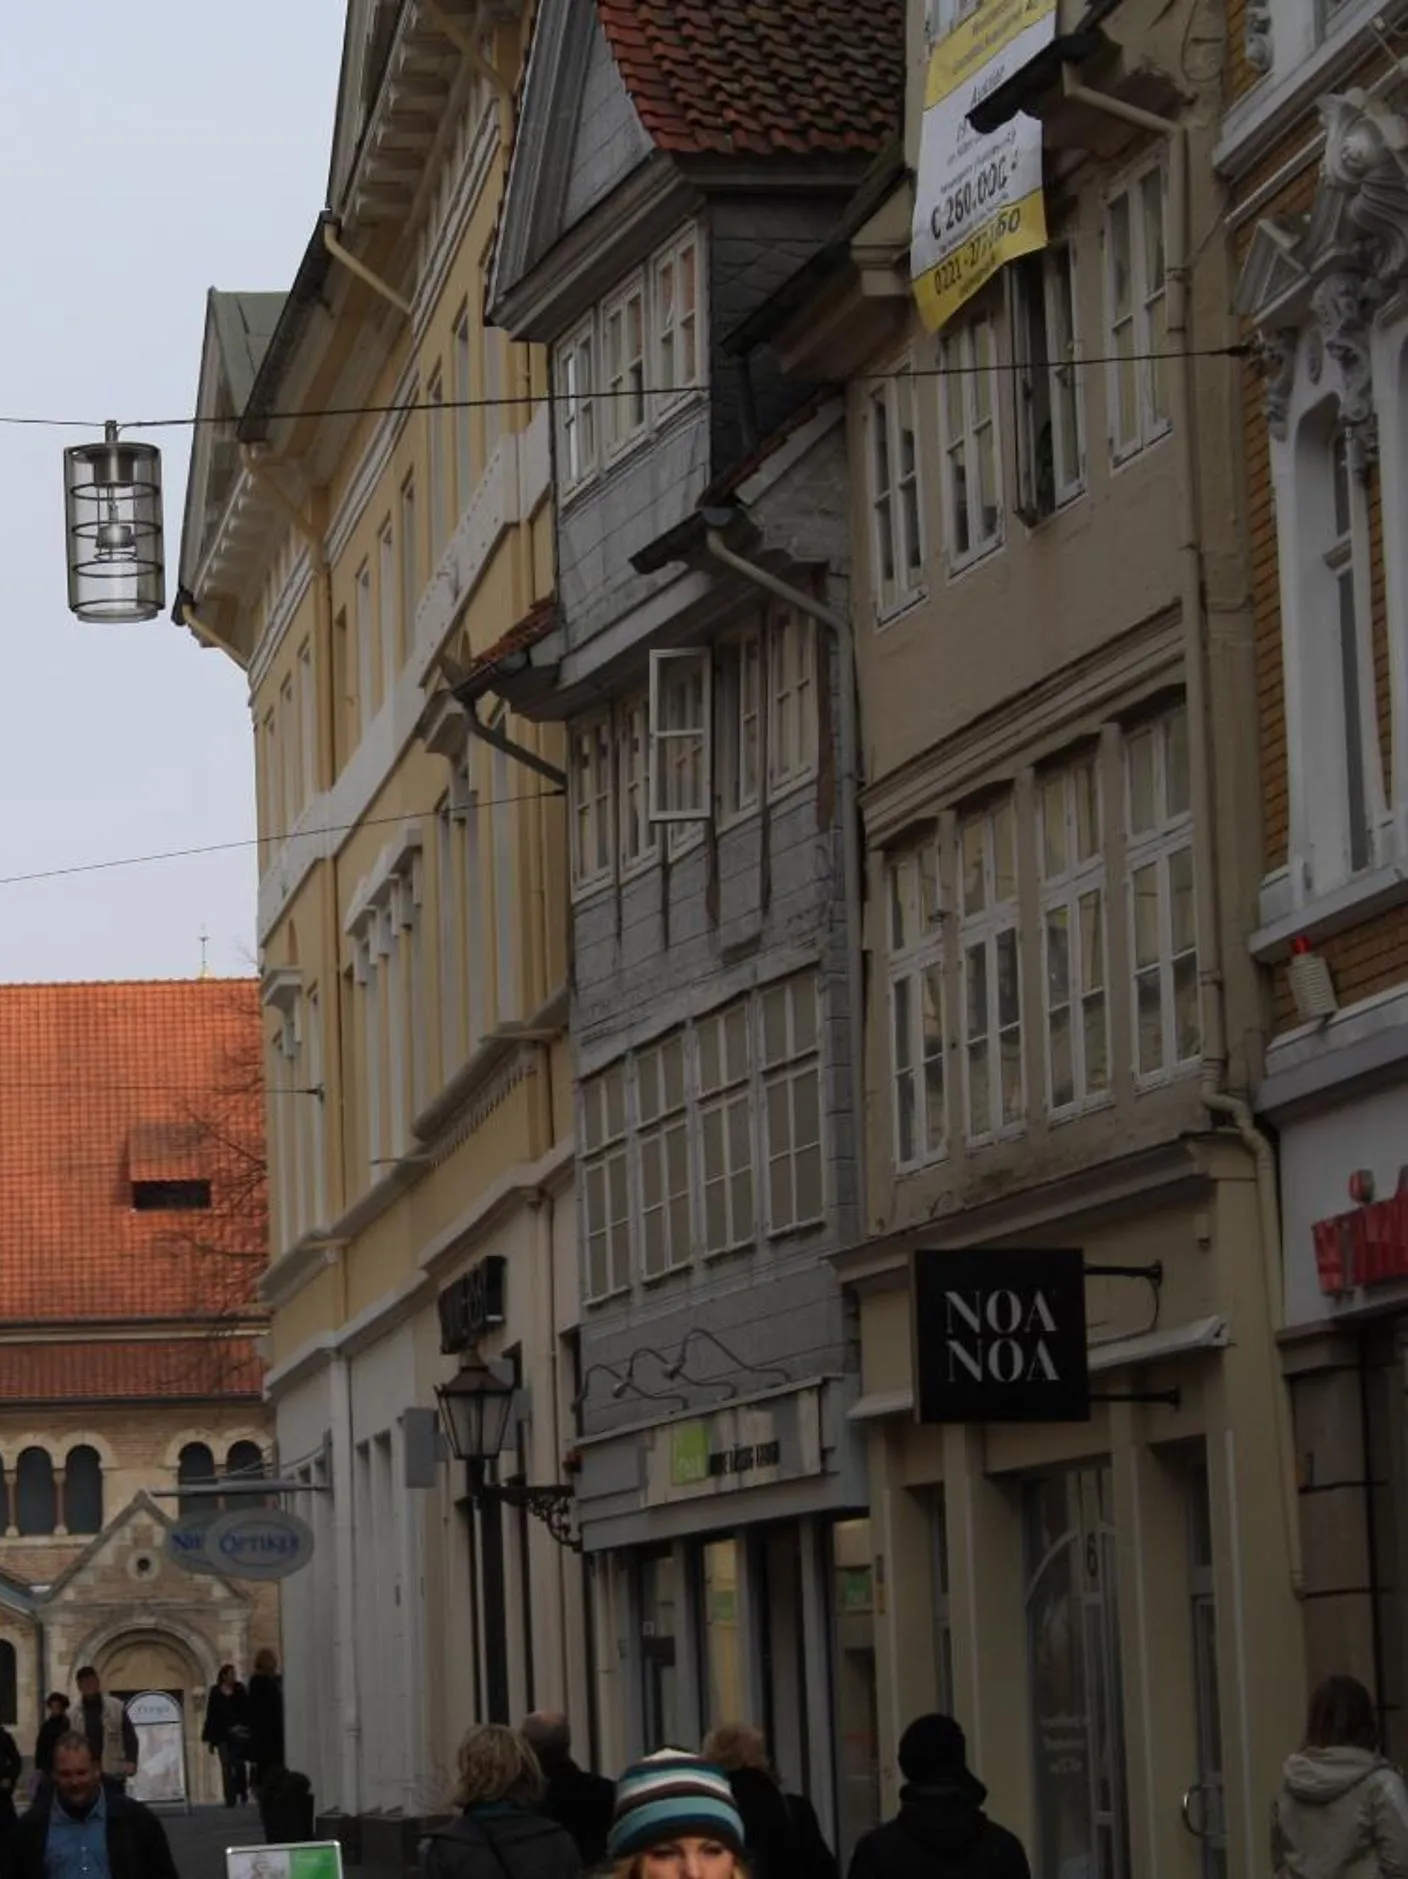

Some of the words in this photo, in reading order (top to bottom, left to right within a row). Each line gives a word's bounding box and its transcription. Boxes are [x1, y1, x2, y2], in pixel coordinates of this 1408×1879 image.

[944, 1289, 1059, 1335] NOA
[946, 1338, 1061, 1383] NOA
[1086, 1530, 1099, 1578] 6
